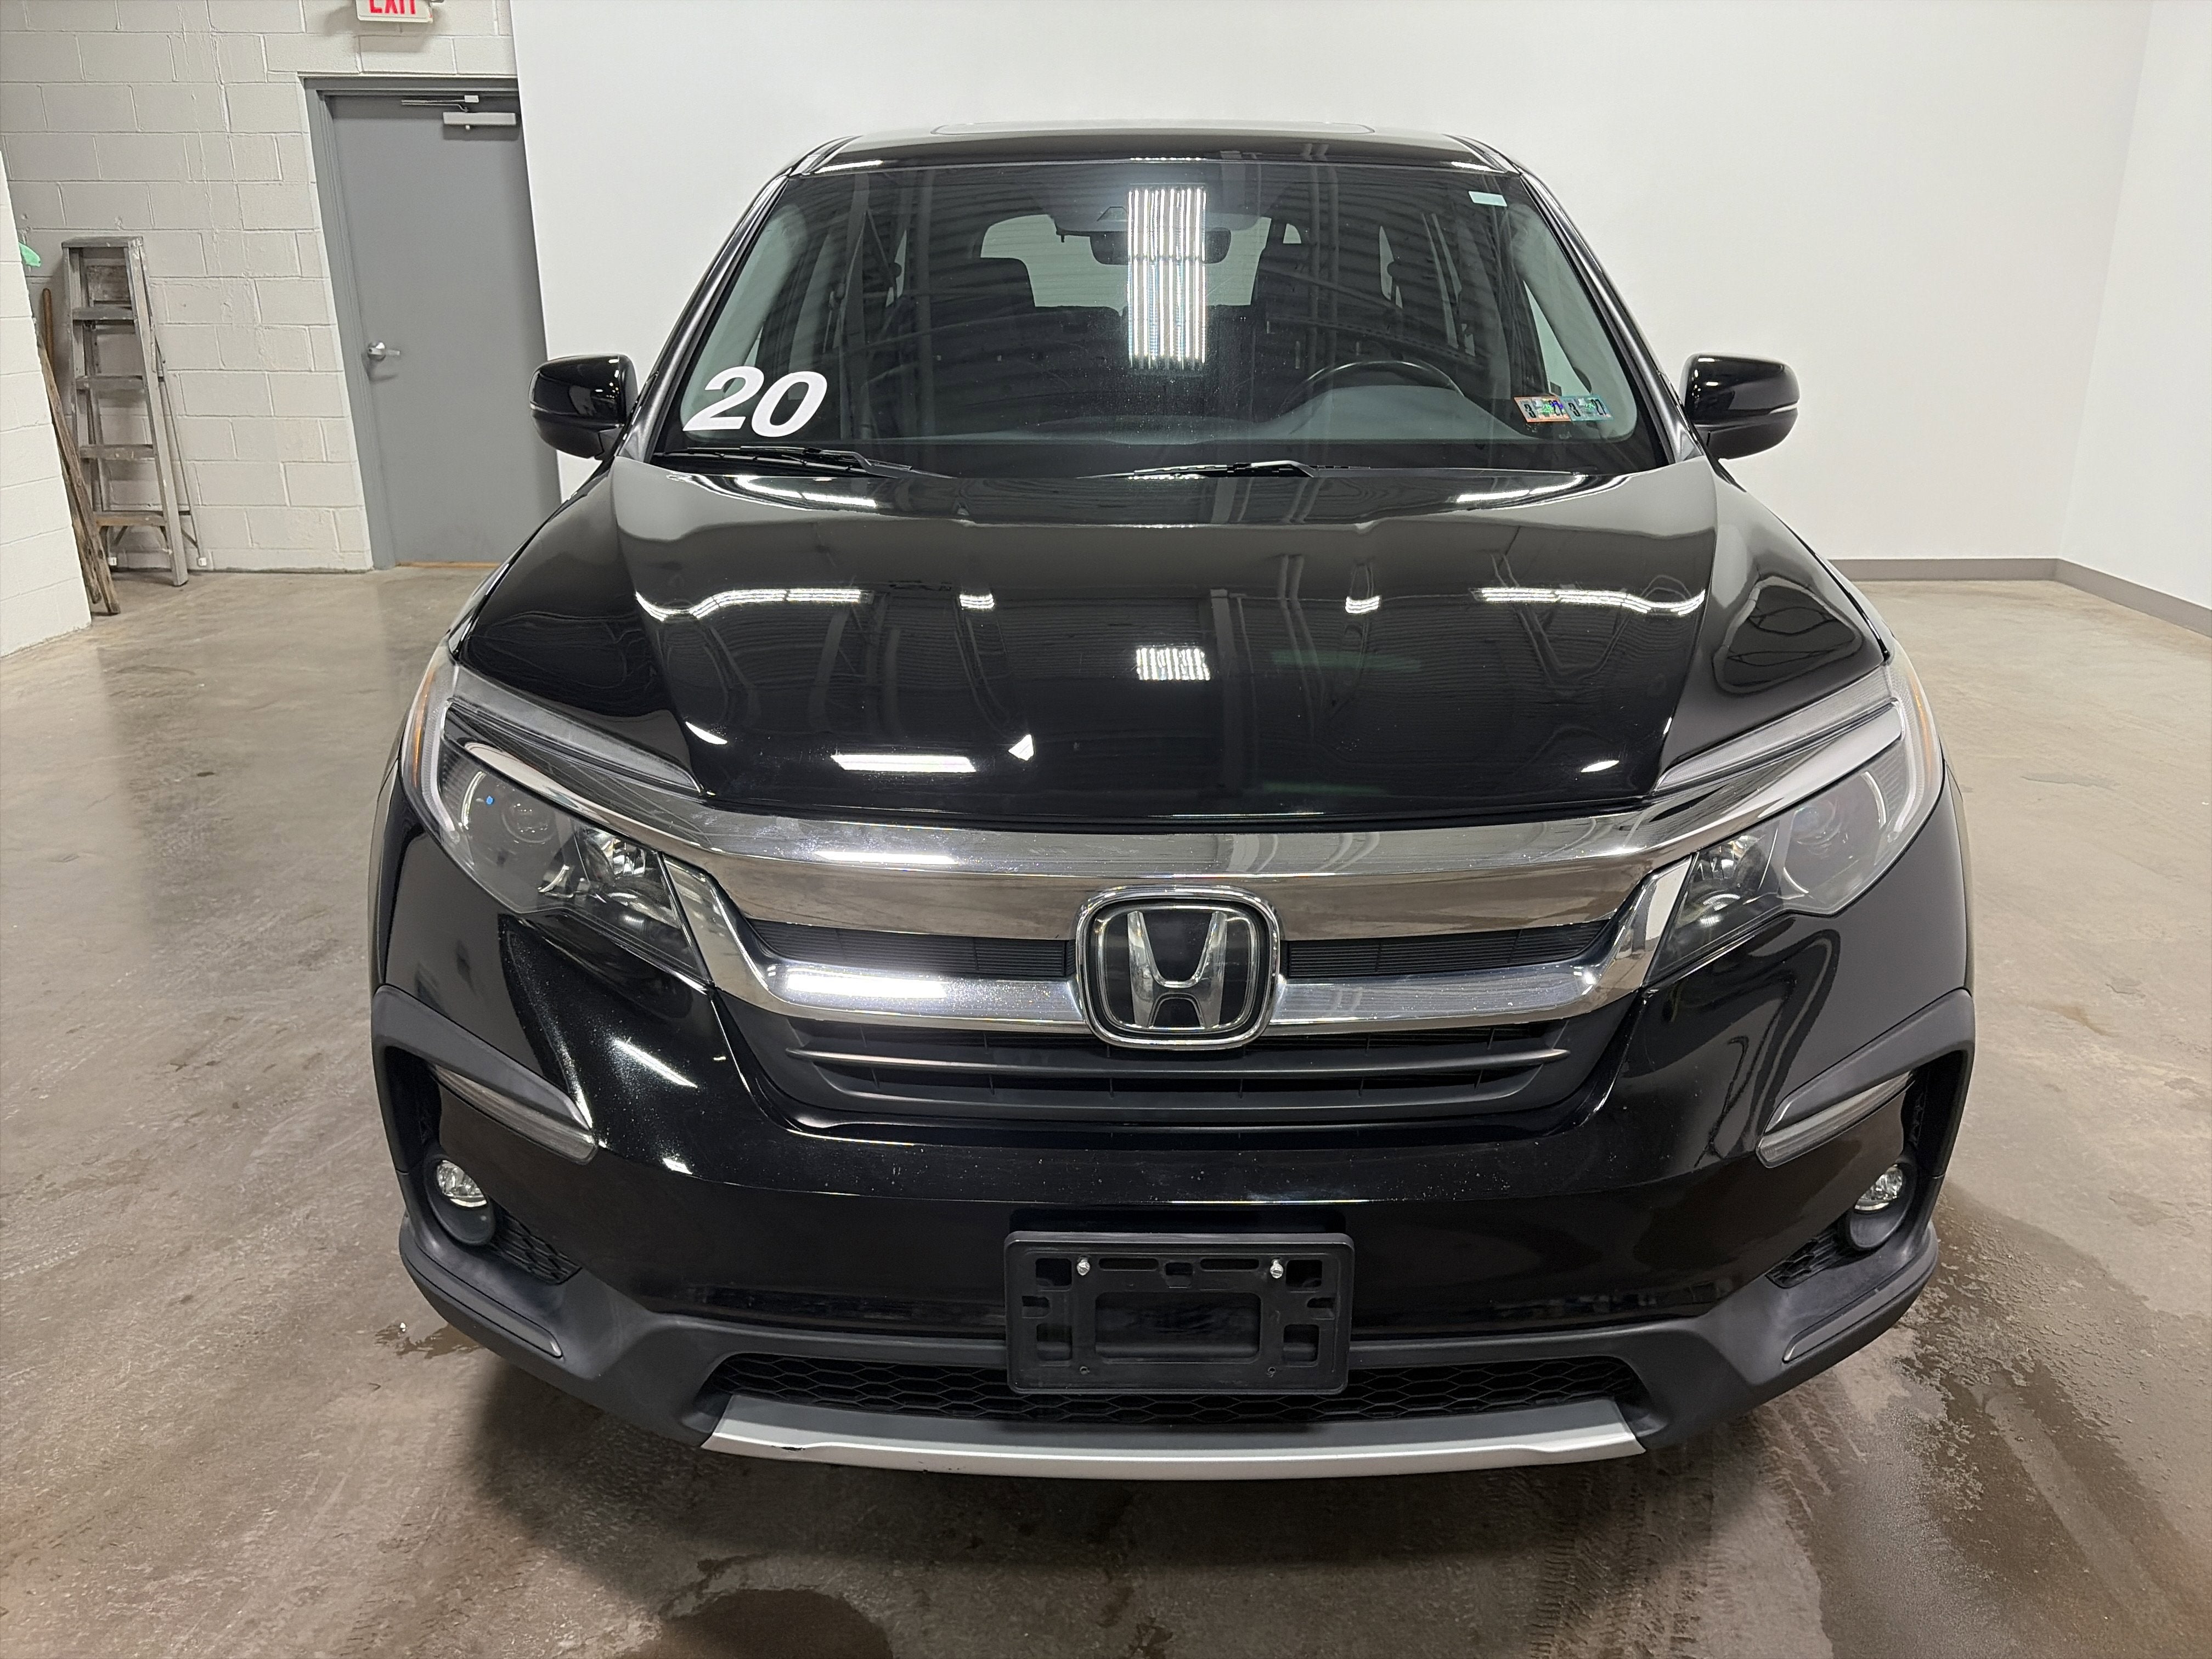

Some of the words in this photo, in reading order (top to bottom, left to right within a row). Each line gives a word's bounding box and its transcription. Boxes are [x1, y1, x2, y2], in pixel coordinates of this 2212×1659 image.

[682, 366, 827, 437] 20
[1524, 404, 1537, 418] 3
[1568, 402, 1581, 417] 3
